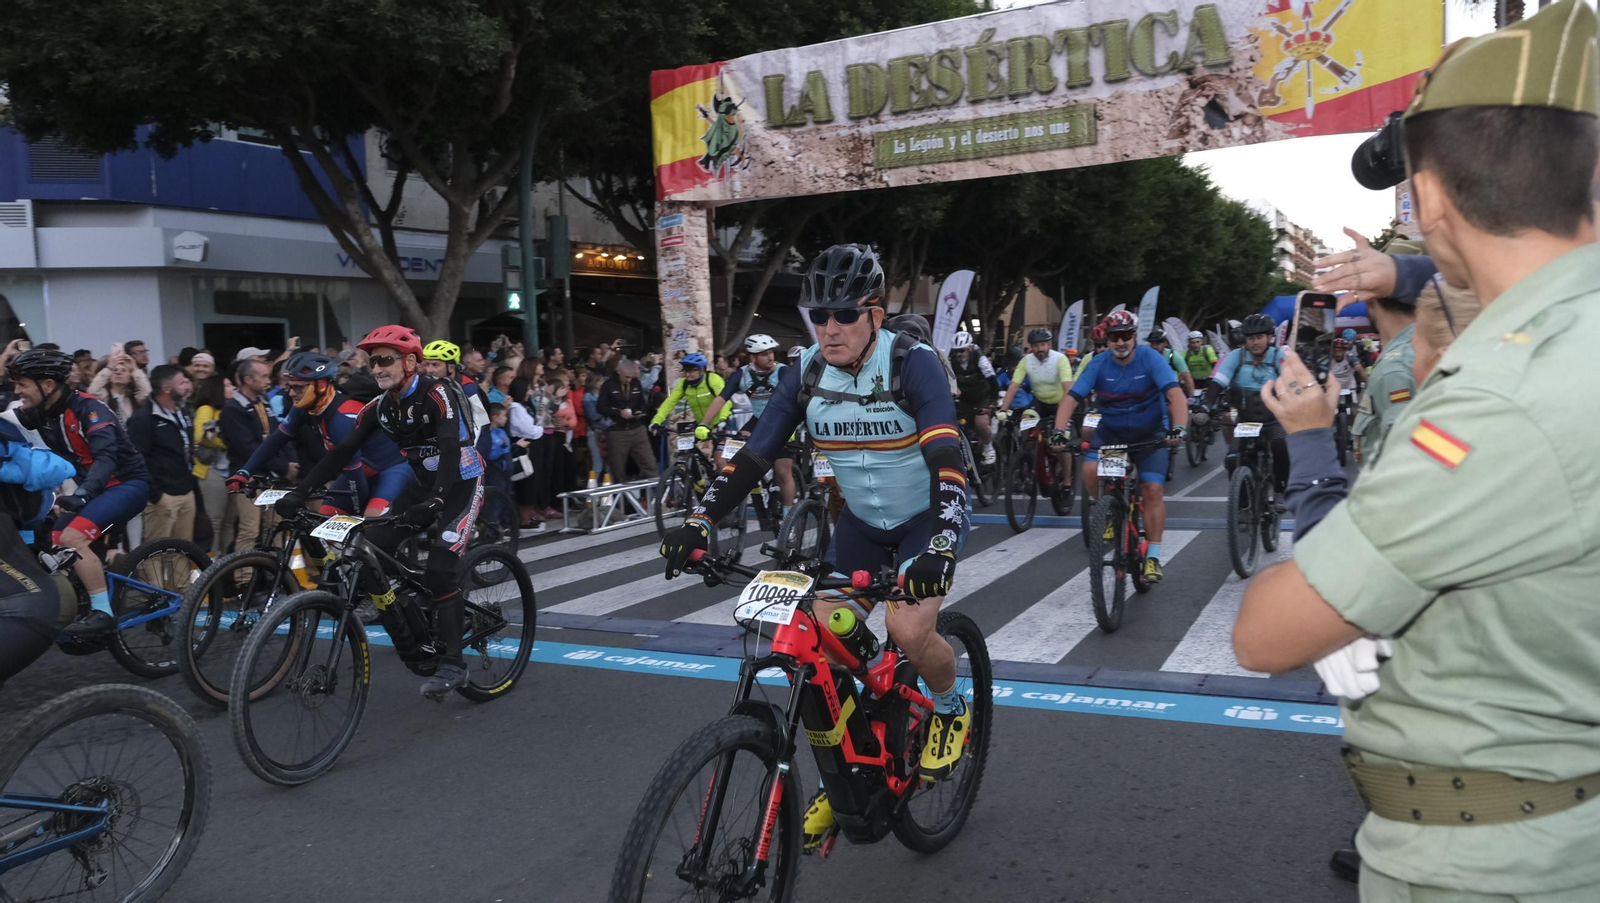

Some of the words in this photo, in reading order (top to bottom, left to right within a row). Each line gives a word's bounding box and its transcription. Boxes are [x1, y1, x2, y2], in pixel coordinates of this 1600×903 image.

[763, 73, 834, 128] LA
[845, 3, 1232, 119] DESÉRTICA
[894, 139, 906, 154] La
[909, 134, 944, 152] Legión
[949, 135, 956, 149] y
[961, 130, 972, 145] el
[975, 125, 1020, 143] desierto
[1024, 124, 1044, 138] nos
[1049, 121, 1070, 134] une
[815, 422, 830, 436] LA
[833, 418, 904, 436] DESÉRTICA
[321, 521, 351, 532] 10064
[748, 583, 799, 607] 10098
[603, 655, 717, 671] cajamar
[1020, 692, 1177, 712] cajamar
